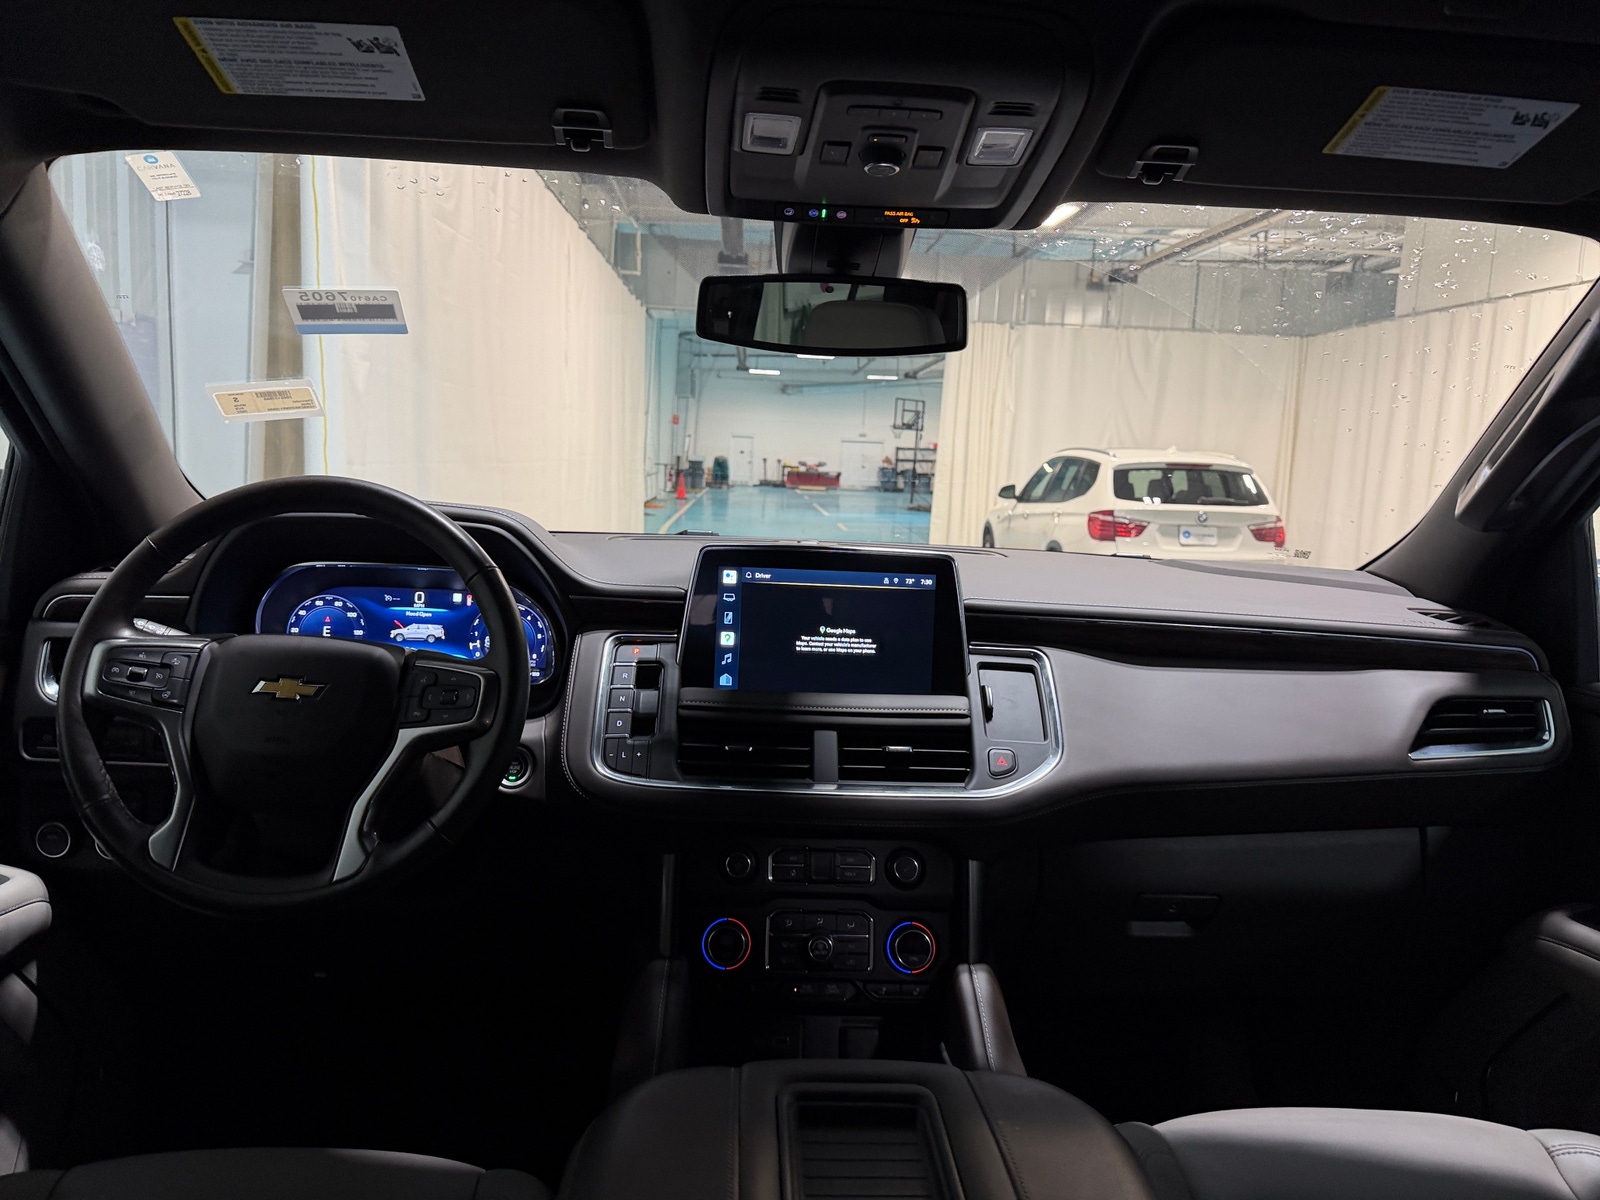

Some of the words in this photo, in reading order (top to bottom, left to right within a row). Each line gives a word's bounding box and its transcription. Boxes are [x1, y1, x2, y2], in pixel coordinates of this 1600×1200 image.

[137, 163, 176, 171] CARVANA
[414, 591, 425, 603] 0
[322, 625, 331, 637] E
